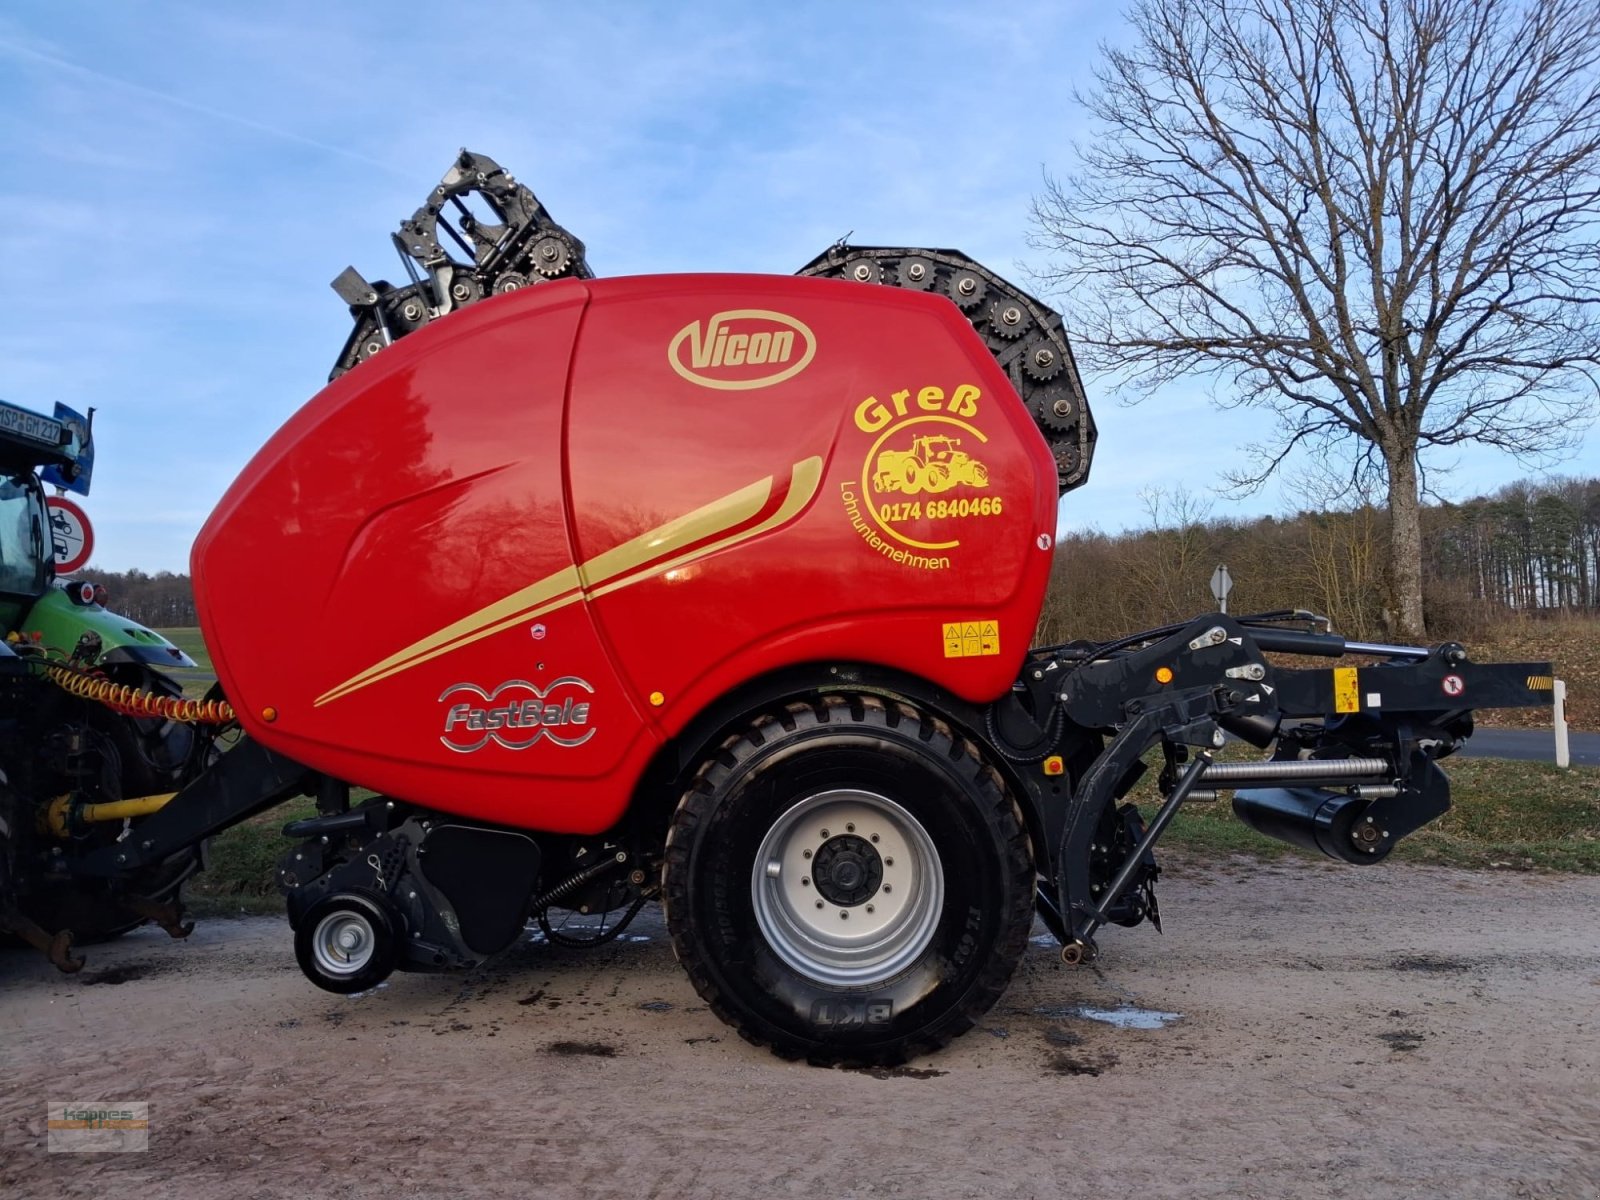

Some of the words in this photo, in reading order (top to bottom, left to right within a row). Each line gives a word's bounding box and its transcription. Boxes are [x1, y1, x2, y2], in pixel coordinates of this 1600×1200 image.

[690, 314, 795, 369] Vicon
[854, 384, 981, 433] Greß
[25, 416, 39, 436] GM
[41, 421, 60, 441] 217
[840, 481, 950, 570] Lohnunternehmen
[881, 499, 922, 523] 0174
[926, 497, 1002, 519] 6840466
[445, 697, 590, 732] FastBale
[815, 1003, 891, 1025] BKT
